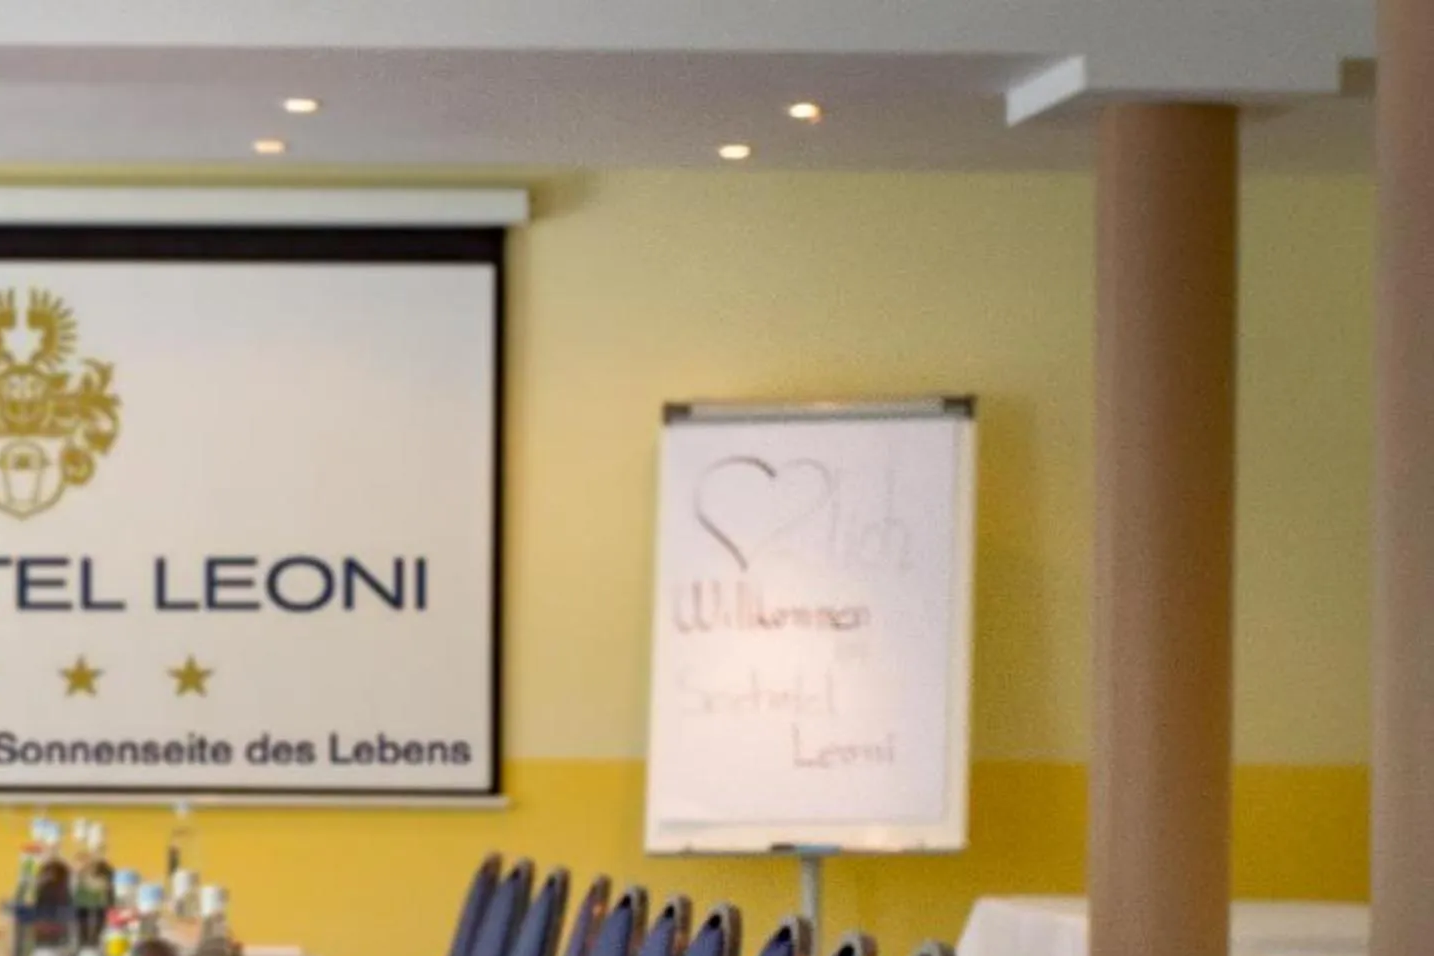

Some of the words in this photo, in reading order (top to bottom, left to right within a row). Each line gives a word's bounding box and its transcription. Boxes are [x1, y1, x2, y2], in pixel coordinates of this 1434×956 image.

[154, 554, 428, 614] LEONI
[243, 731, 318, 766] des
[327, 731, 473, 767] Lebens
